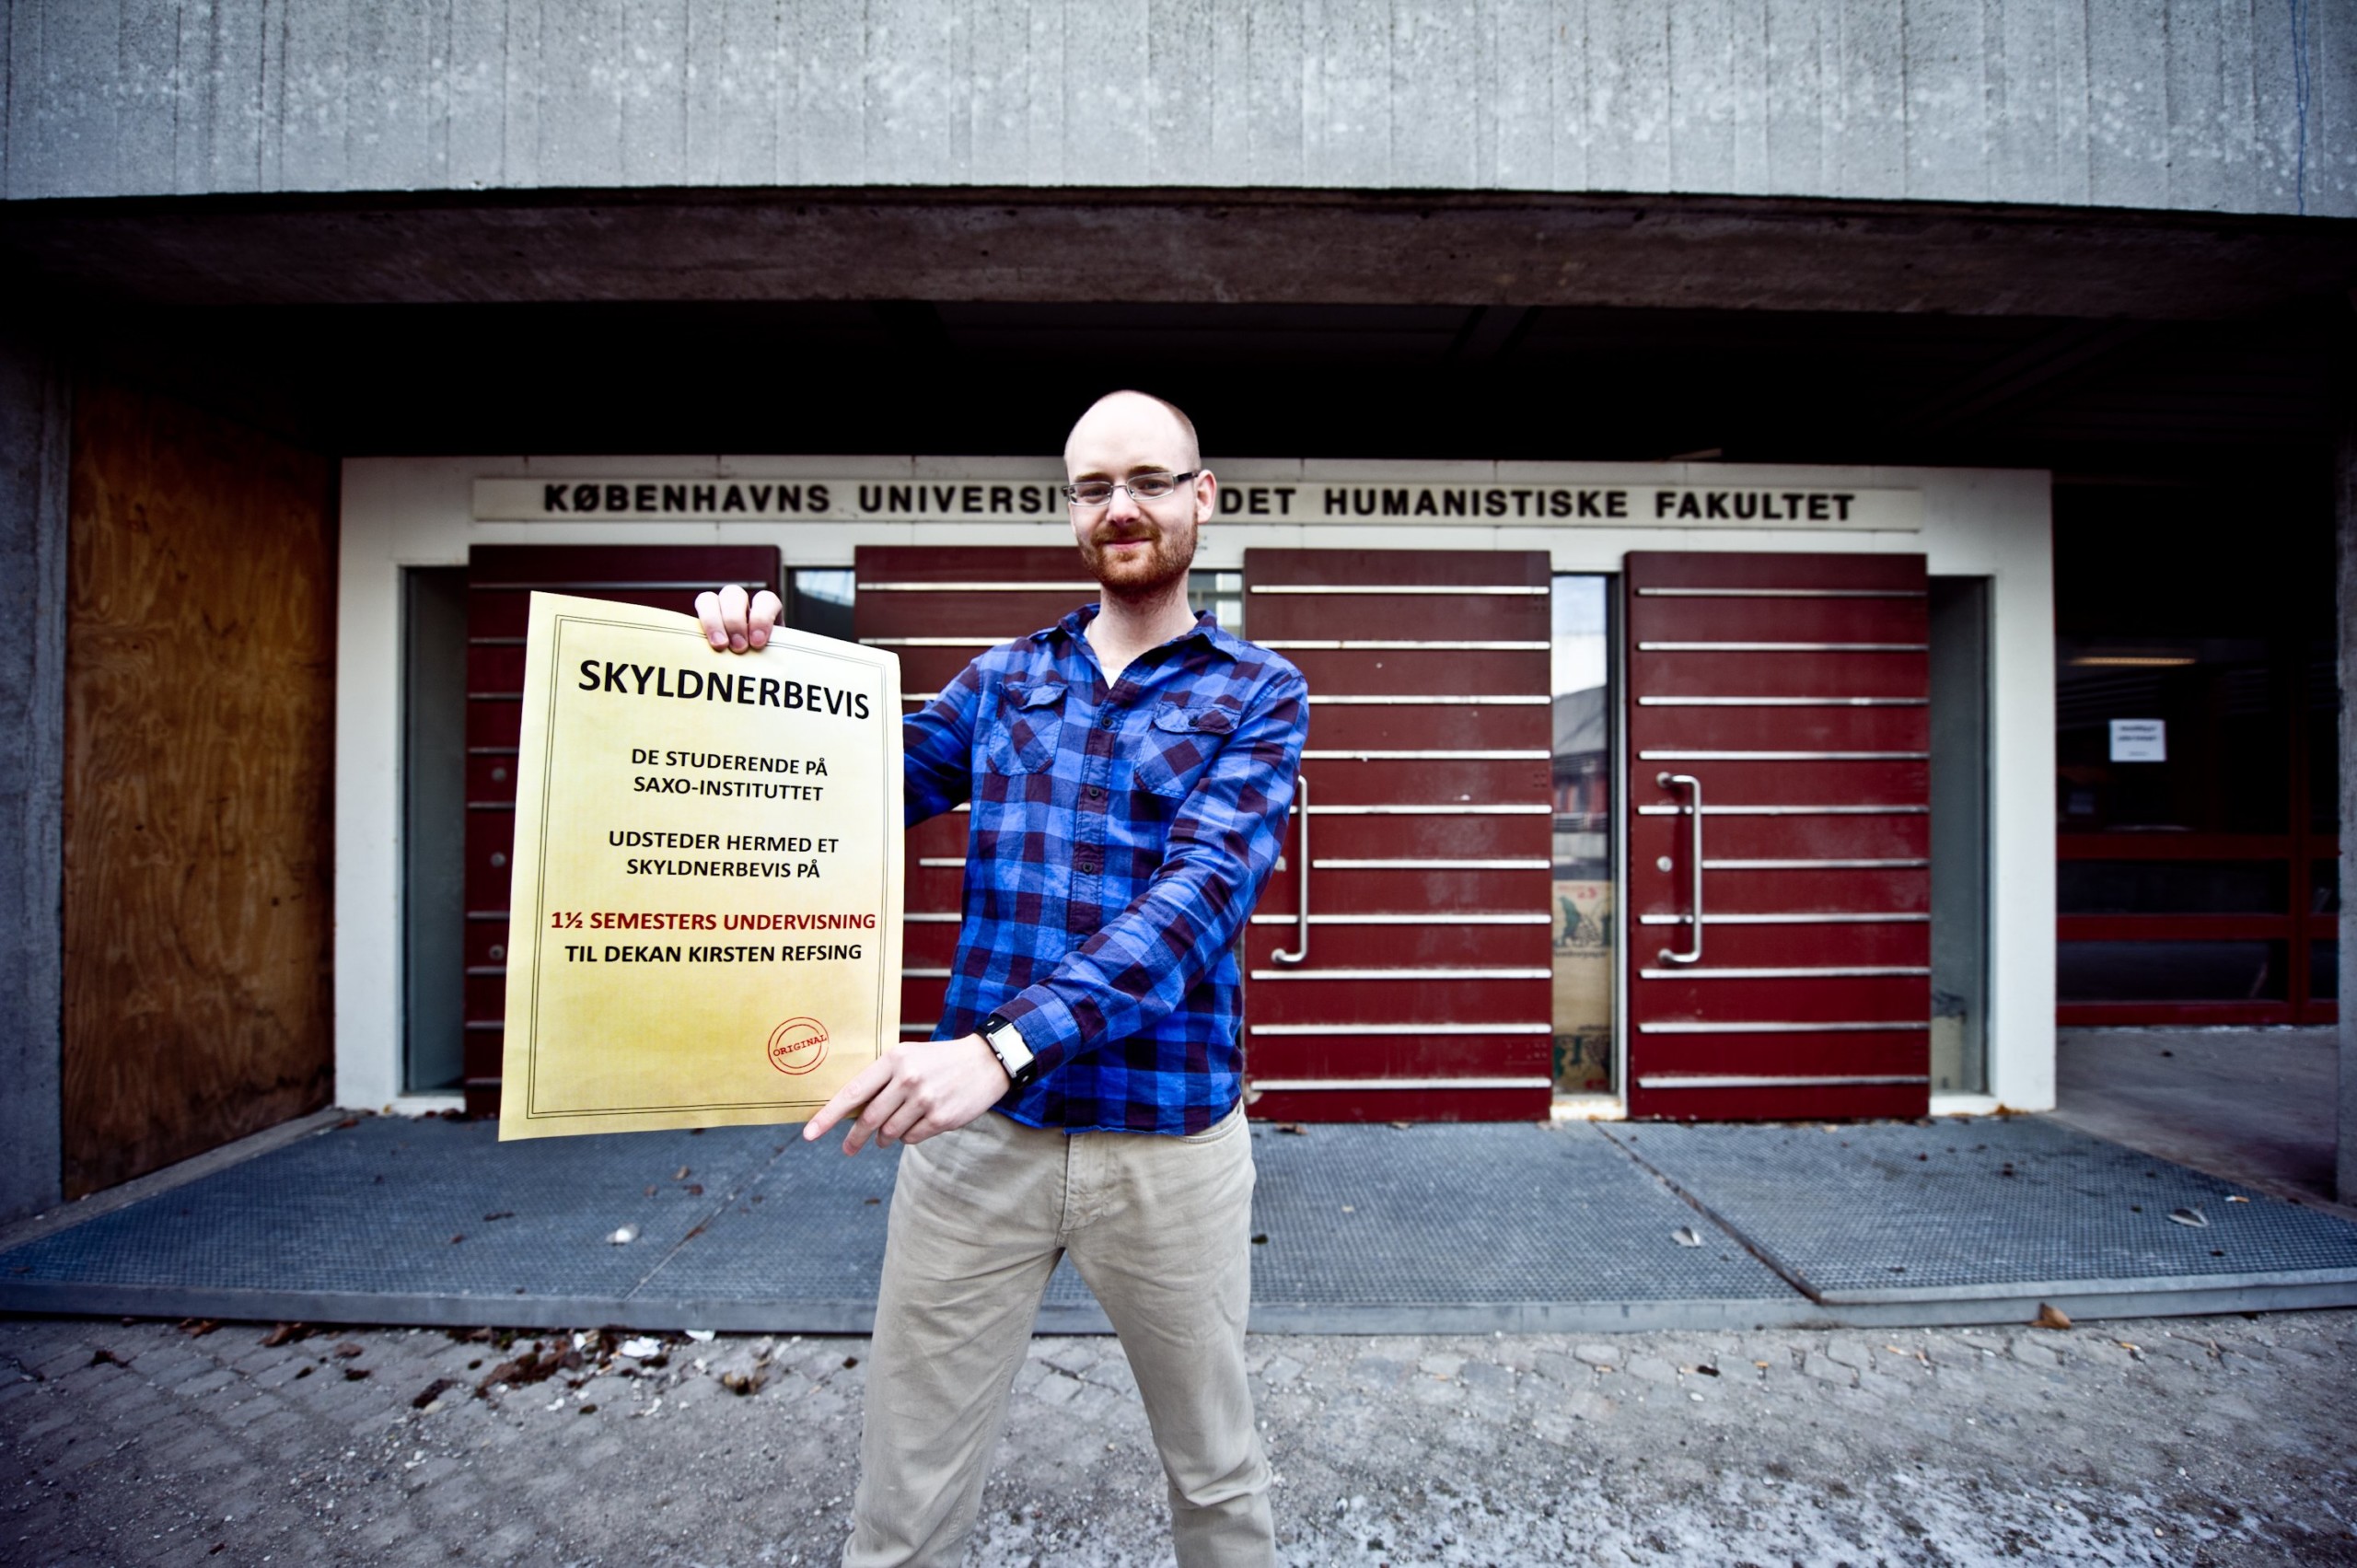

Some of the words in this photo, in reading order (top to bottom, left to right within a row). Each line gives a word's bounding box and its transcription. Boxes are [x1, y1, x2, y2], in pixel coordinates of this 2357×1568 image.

[542, 483, 830, 514] KØBENHAVNS
[1219, 486, 1296, 515] DET
[1324, 488, 1628, 518] HUMANISTISKE
[1655, 491, 1855, 521] FAKULTET
[578, 659, 870, 720] SKYLDNERBEVIS
[632, 748, 660, 766] DE
[665, 750, 800, 774] STUDERENDE
[806, 757, 828, 777] PÅ
[633, 775, 824, 802] SAXO-INSTITUTTET
[609, 830, 720, 850] UDSTEDER
[726, 834, 812, 853] HERMED
[818, 838, 840, 854] ET
[626, 858, 791, 878] SKYLDNERBEVIS
[797, 858, 820, 878] PÅ
[551, 912, 583, 929] 1½
[589, 912, 717, 931] SEMESTERS
[724, 913, 876, 931] UNDERVISNING
[564, 945, 598, 963] TIL
[604, 946, 681, 963] DEKAN
[689, 946, 775, 963] KIRSTEN
[782, 944, 862, 962] REFSING
[772, 1034, 828, 1057] ORIGINAL
